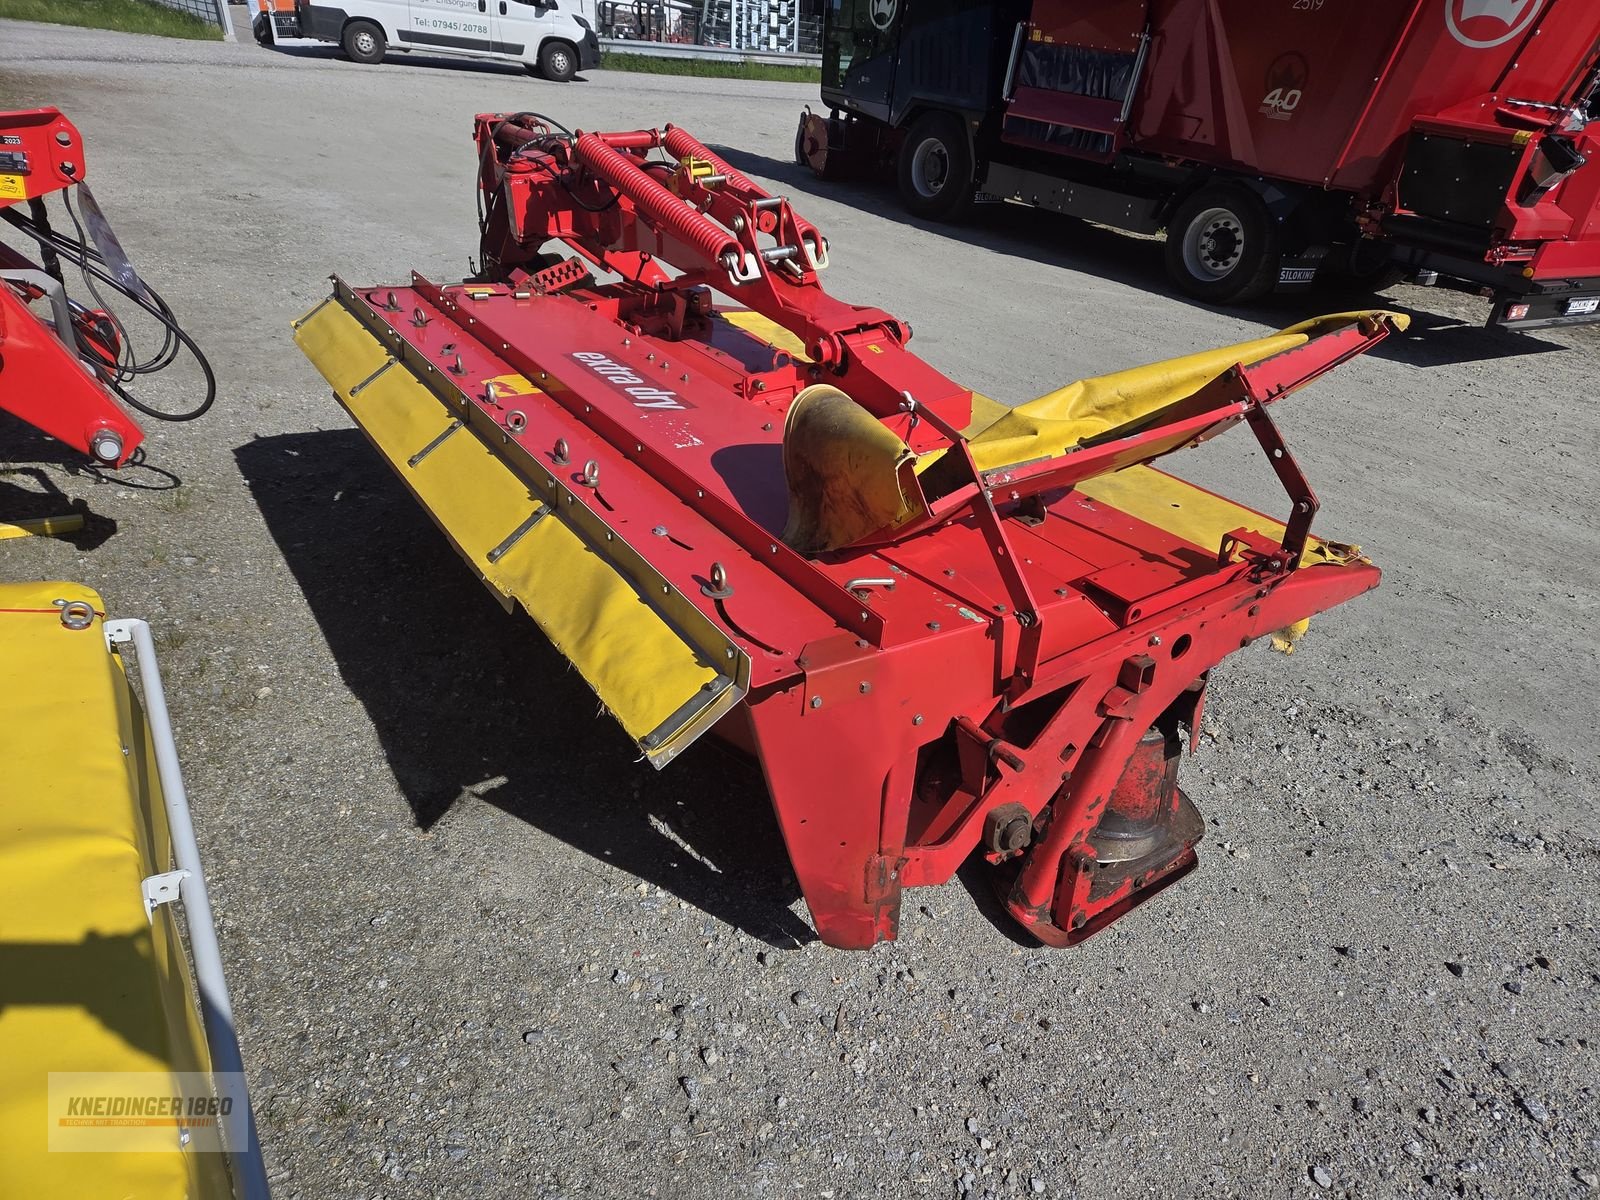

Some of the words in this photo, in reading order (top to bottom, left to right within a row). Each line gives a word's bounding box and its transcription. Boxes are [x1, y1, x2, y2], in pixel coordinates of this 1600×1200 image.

[414, 17, 430, 27] Tel:
[1280, 270, 1315, 280] SILOKING
[572, 352, 644, 384] extra
[624, 387, 687, 410] dry
